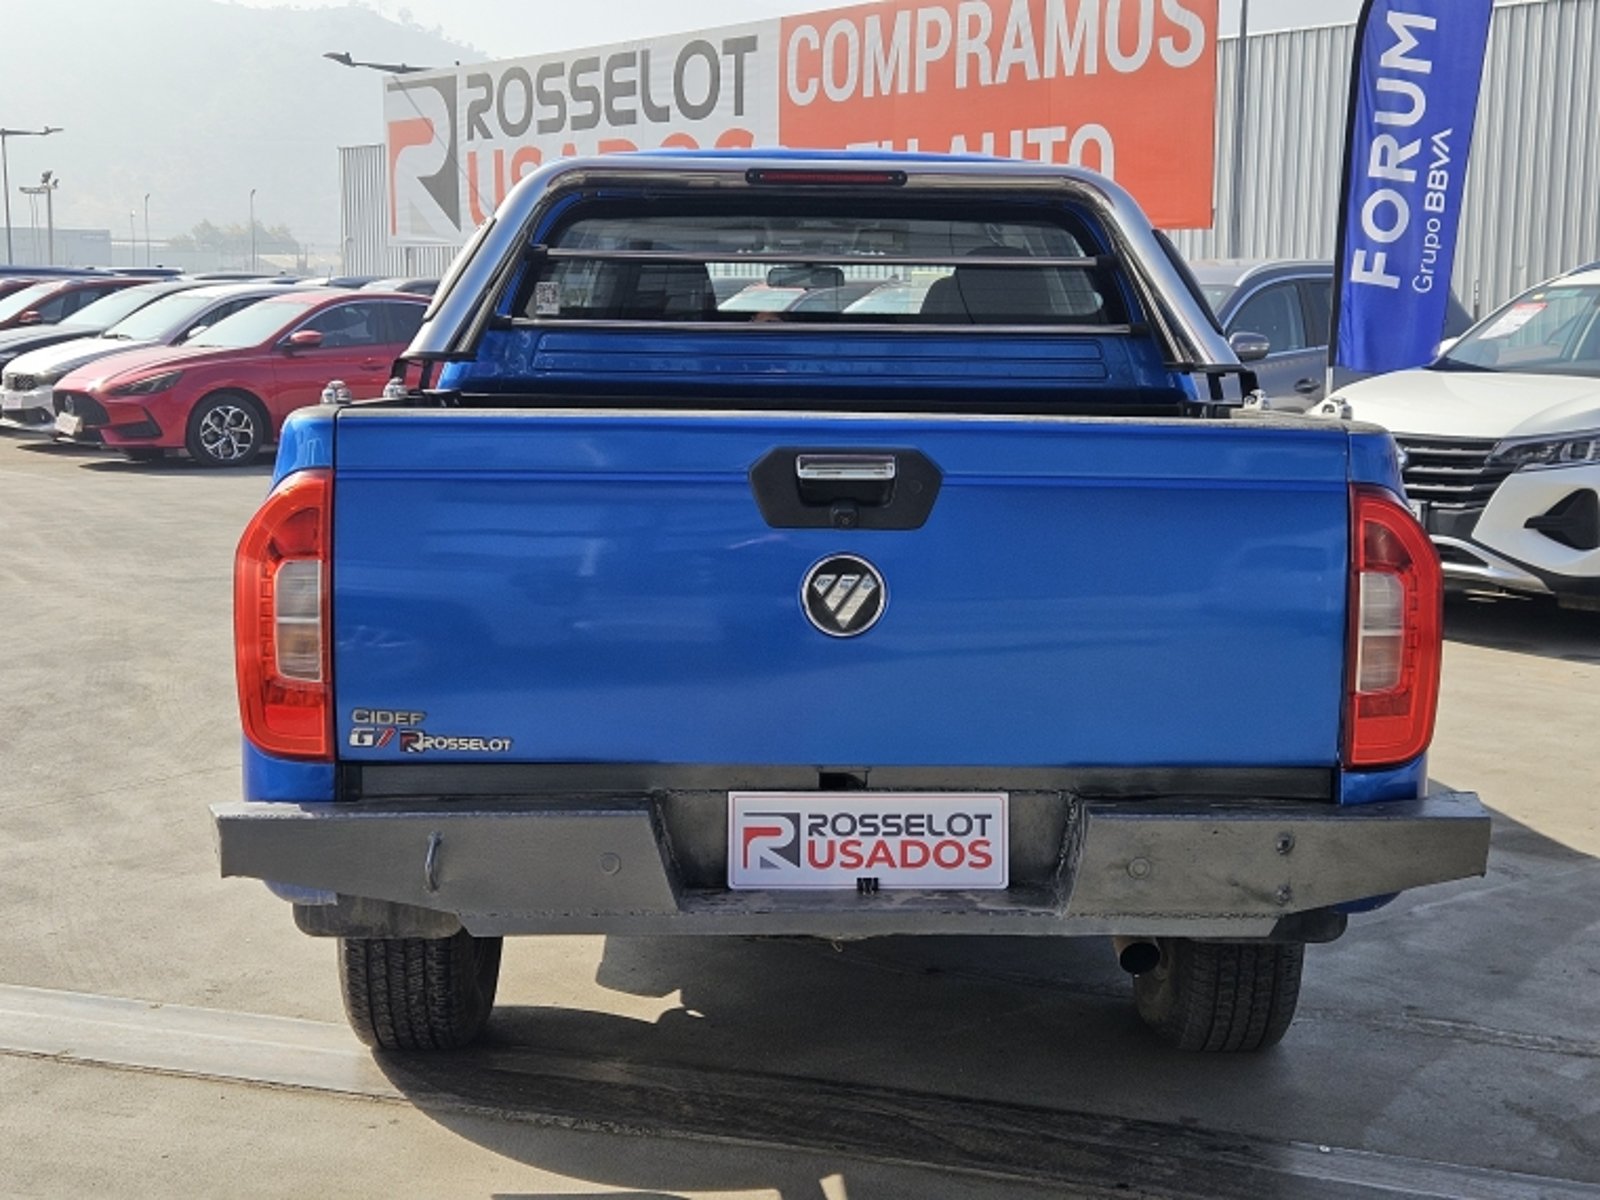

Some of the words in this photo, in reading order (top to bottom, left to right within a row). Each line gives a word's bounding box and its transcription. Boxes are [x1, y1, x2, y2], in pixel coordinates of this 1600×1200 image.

[467, 35, 758, 141] ROSSELOT
[786, 0, 1206, 106] COMPRAMOS
[1350, 10, 1437, 290] FORUM
[1424, 127, 1454, 214] BBVA
[1412, 217, 1441, 294] Grupo
[351, 708, 427, 725] CIDEF
[424, 735, 512, 751] ROSSELOT
[808, 812, 993, 837] ROSSELOT
[808, 839, 993, 870] USADOS
